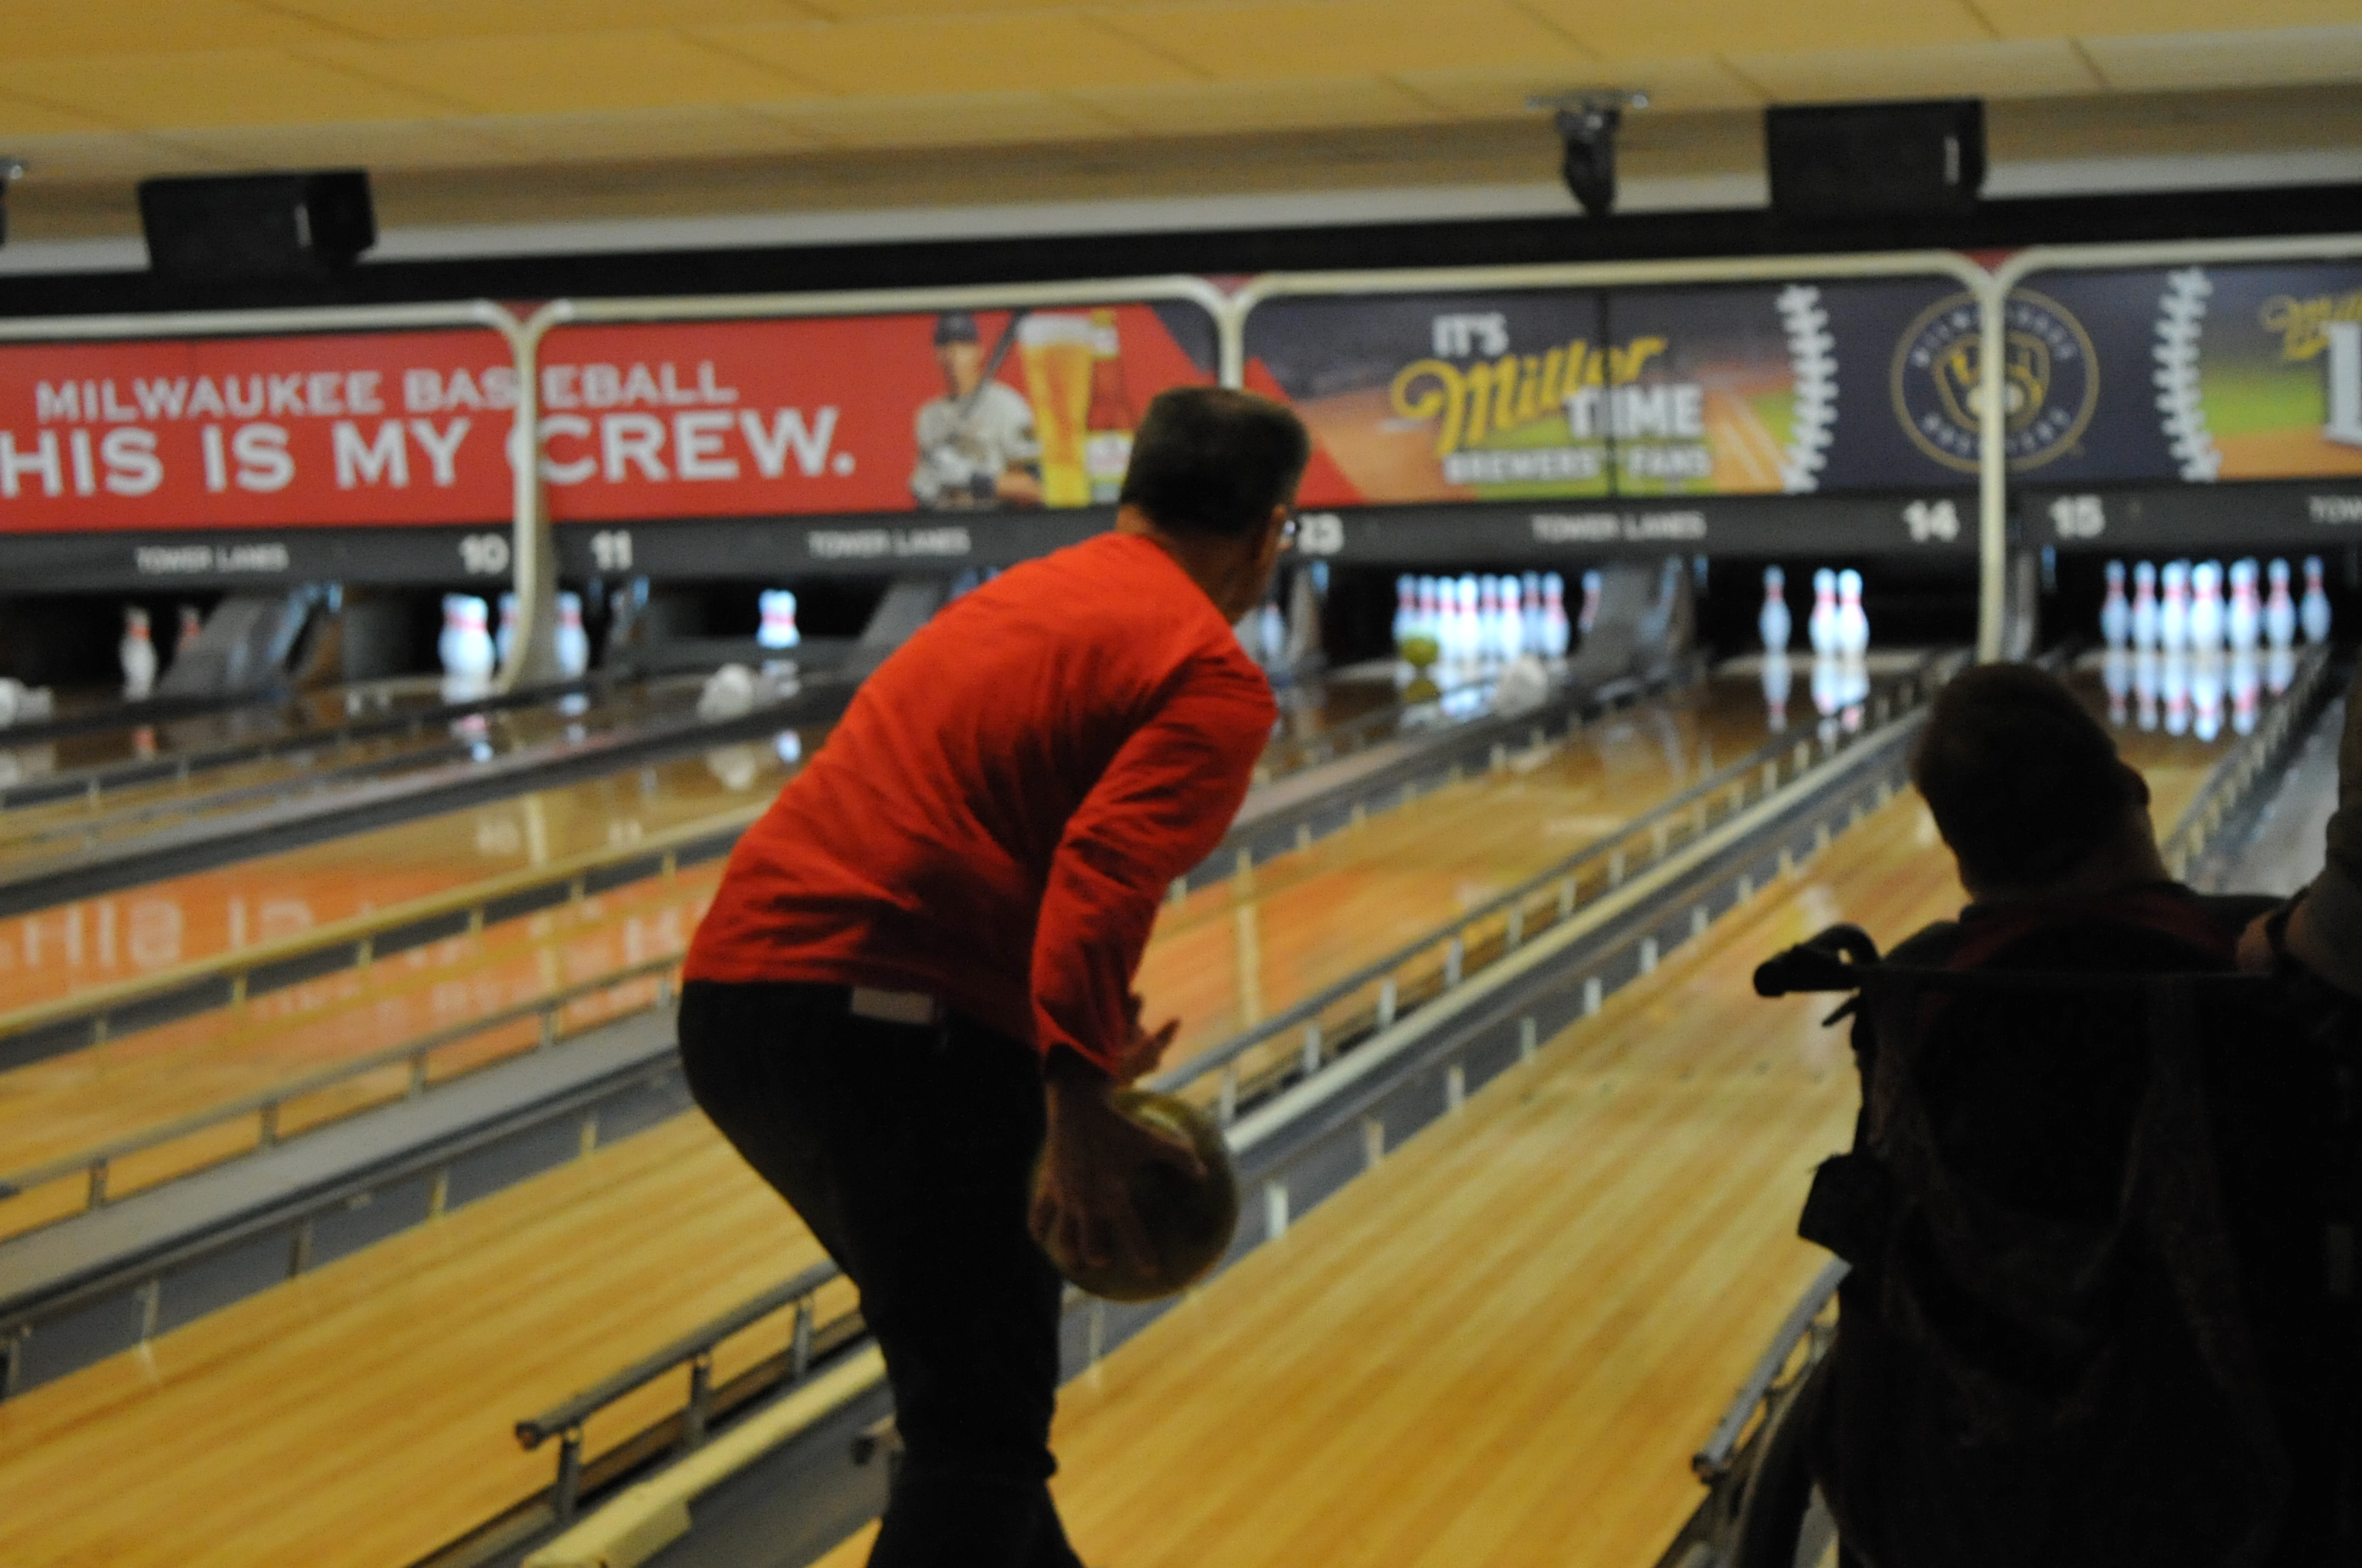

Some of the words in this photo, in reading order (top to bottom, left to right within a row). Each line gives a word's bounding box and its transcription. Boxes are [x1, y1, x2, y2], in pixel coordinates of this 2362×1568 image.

[1433, 312, 1508, 357] IT'S
[36, 371, 384, 424] MILWAUKEE
[1390, 336, 1666, 458] Miller
[1564, 383, 1705, 439] TIME
[202, 423, 294, 492] IS
[332, 417, 470, 489] MY
[1904, 501, 1960, 541] 14
[2050, 496, 2106, 538] 15
[460, 535, 510, 574] 10
[592, 532, 633, 569] 11
